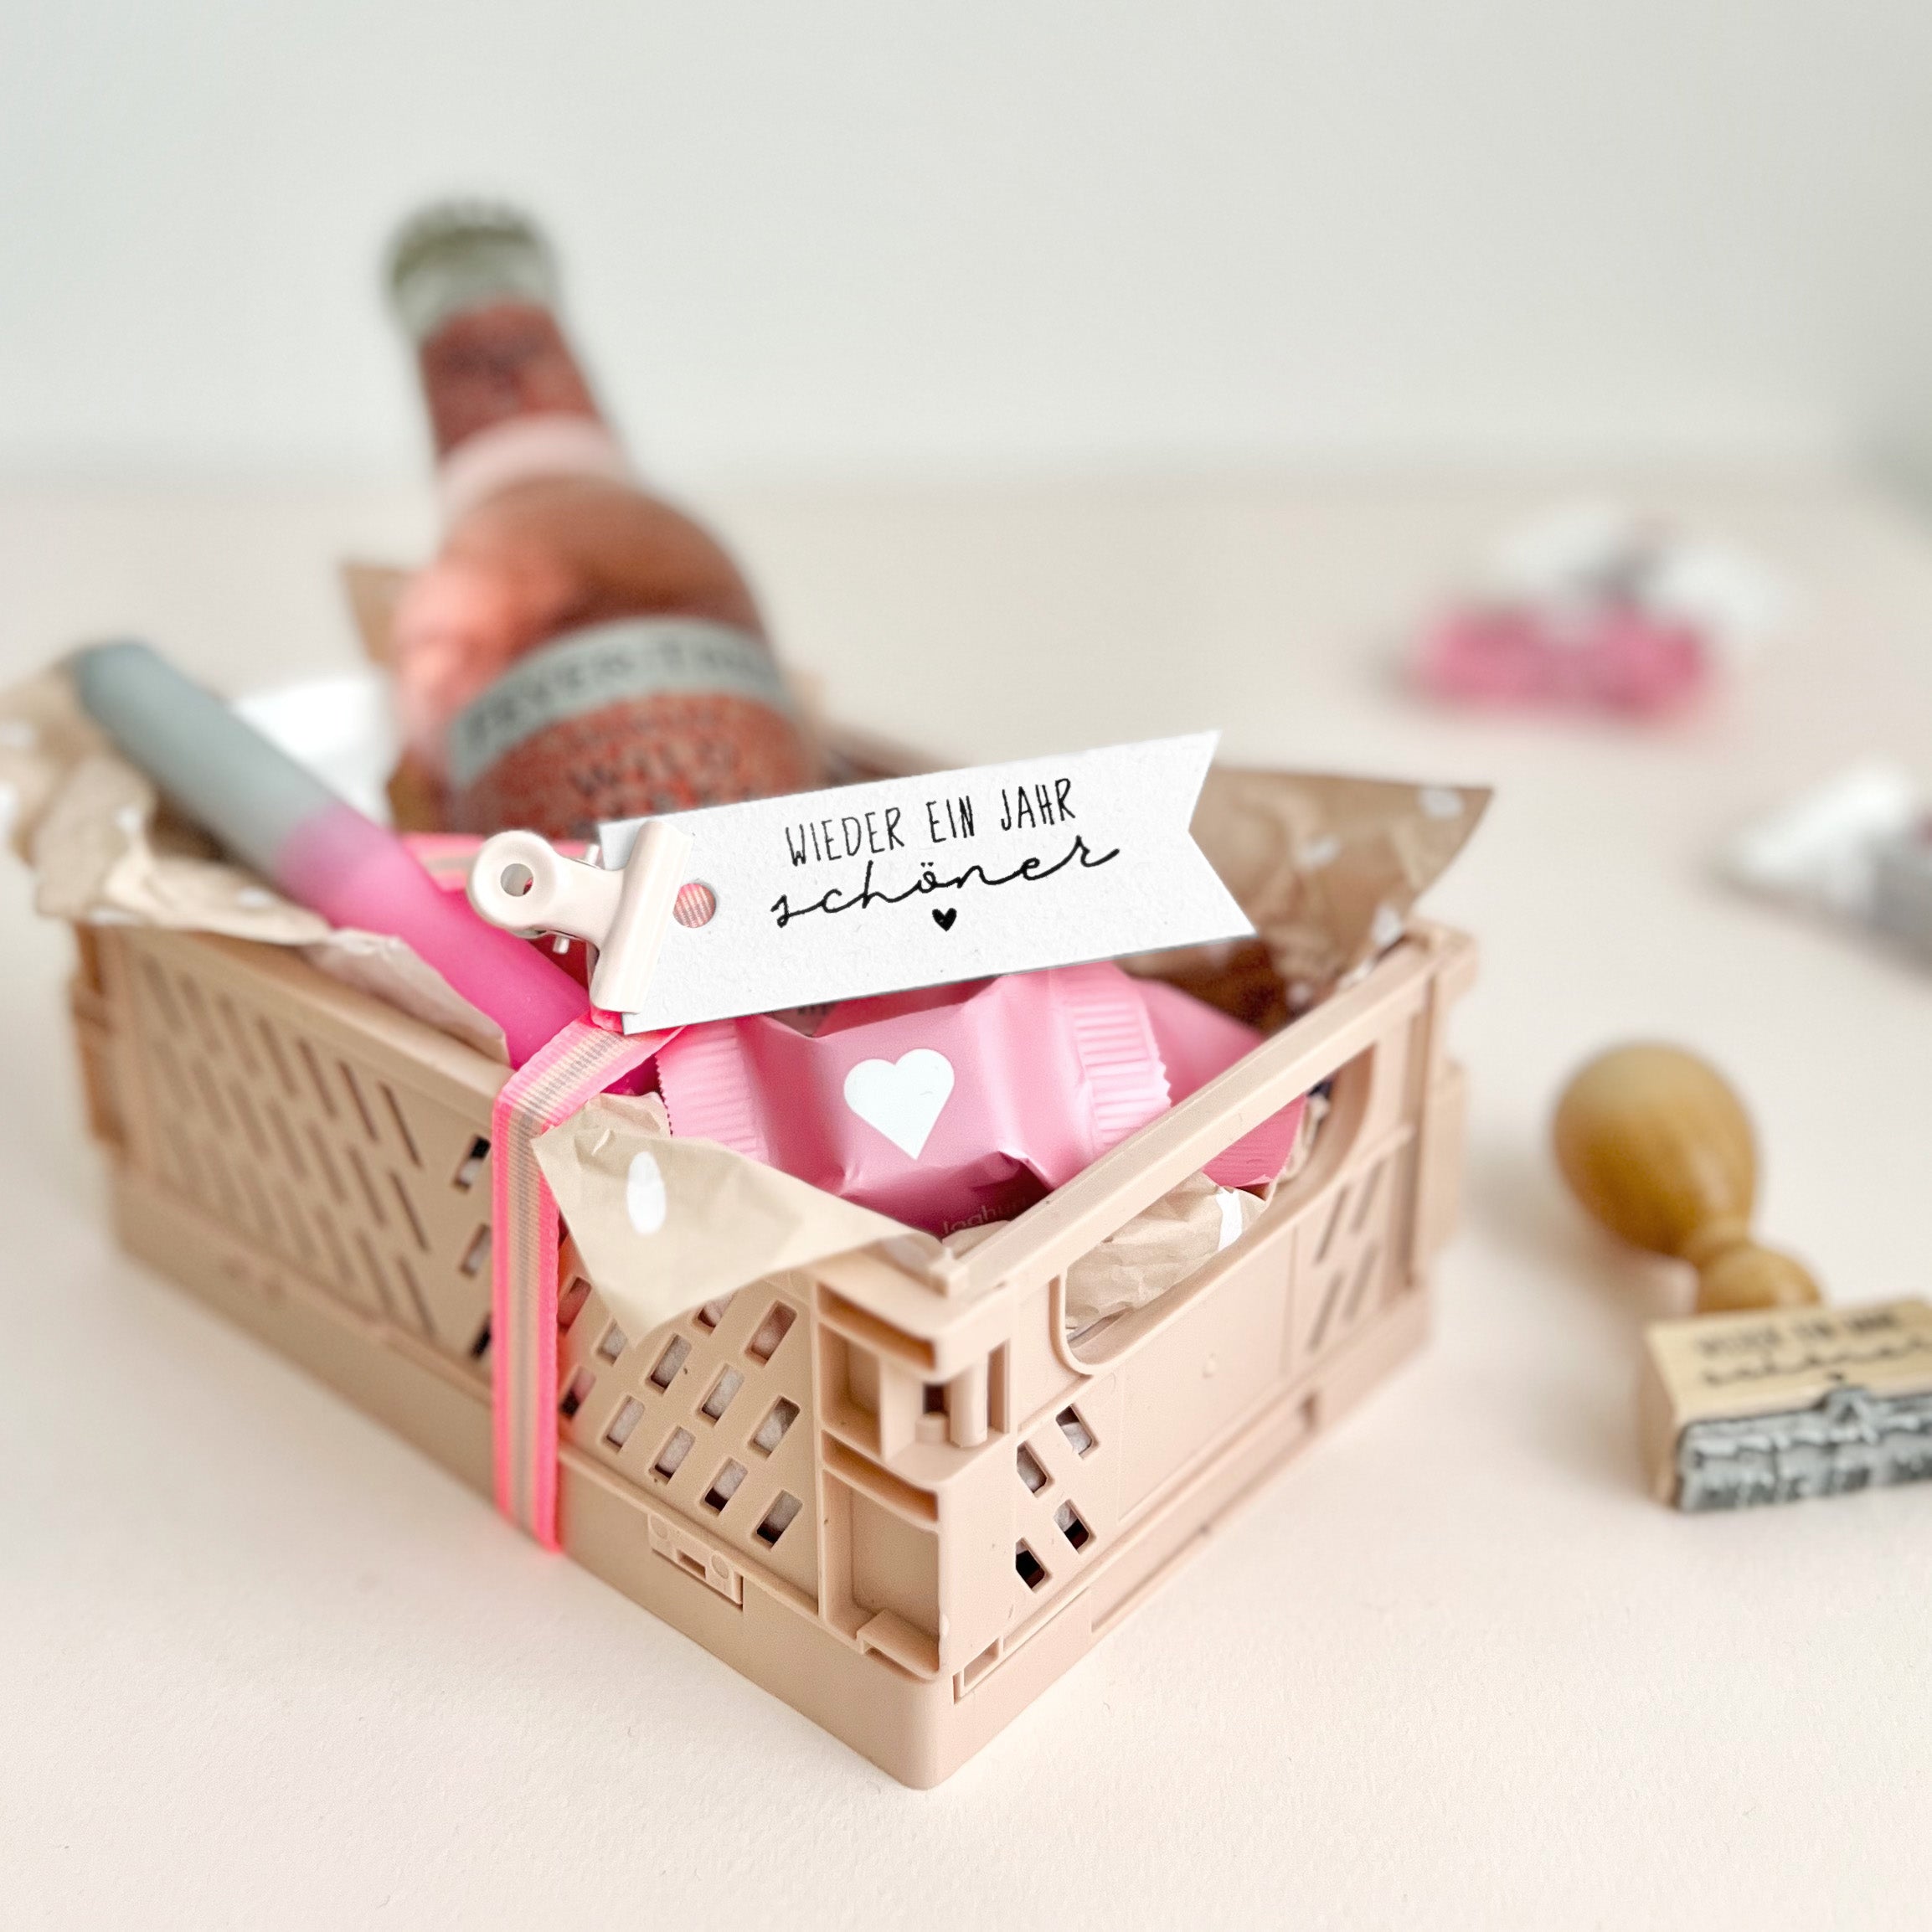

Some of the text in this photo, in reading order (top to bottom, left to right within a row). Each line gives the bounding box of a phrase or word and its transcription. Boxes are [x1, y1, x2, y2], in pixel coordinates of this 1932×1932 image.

[785, 806, 905, 867] WIEDER
[925, 795, 976, 843] EIN
[1000, 777, 1076, 832] JAHR
[770, 834, 1121, 929] schöner
